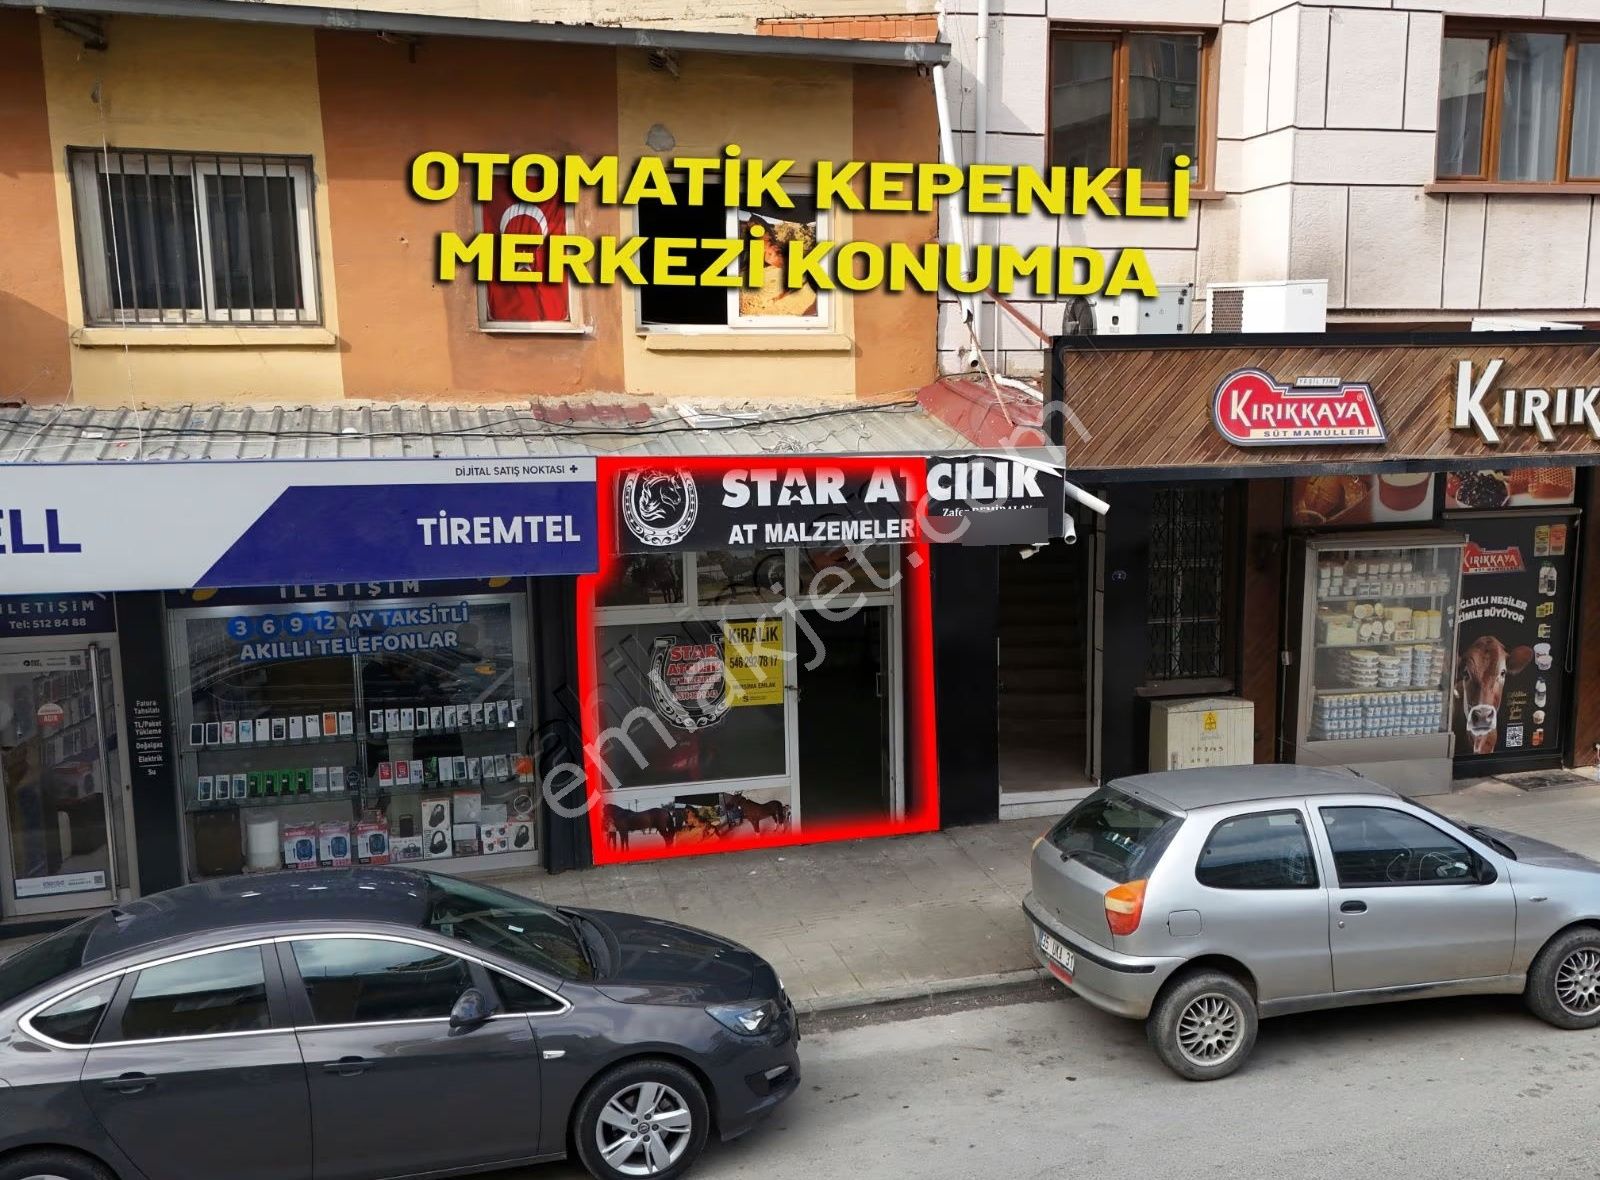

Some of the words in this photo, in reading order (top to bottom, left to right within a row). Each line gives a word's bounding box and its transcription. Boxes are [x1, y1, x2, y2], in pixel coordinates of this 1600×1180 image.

[1230, 389, 1366, 427] KIRIKKAYA
[1263, 429, 1289, 438] SÜT
[1292, 428, 1370, 438] MAMÜLLERİ
[455, 466, 491, 477] DİJİTAL
[493, 466, 520, 477] SATIŞ
[522, 465, 566, 475] NOKTASI
[722, 466, 848, 509] STAR
[0, 508, 82, 554] LL
[416, 509, 581, 546] TİREMTEL
[728, 524, 758, 545] AT
[1490, 596, 1528, 611] NESİLER
[8, 619, 31, 629] Tel:
[33, 618, 52, 629] 512
[234, 620, 247, 636] 3
[262, 619, 274, 635] 6
[290, 617, 302, 631] 9
[316, 615, 336, 631] 12
[349, 612, 376, 629] AY
[379, 602, 469, 626] TAKSİTLİ
[240, 641, 311, 661] AKILLI
[316, 631, 458, 654] TELEFONLAR
[670, 644, 718, 661] STAR
